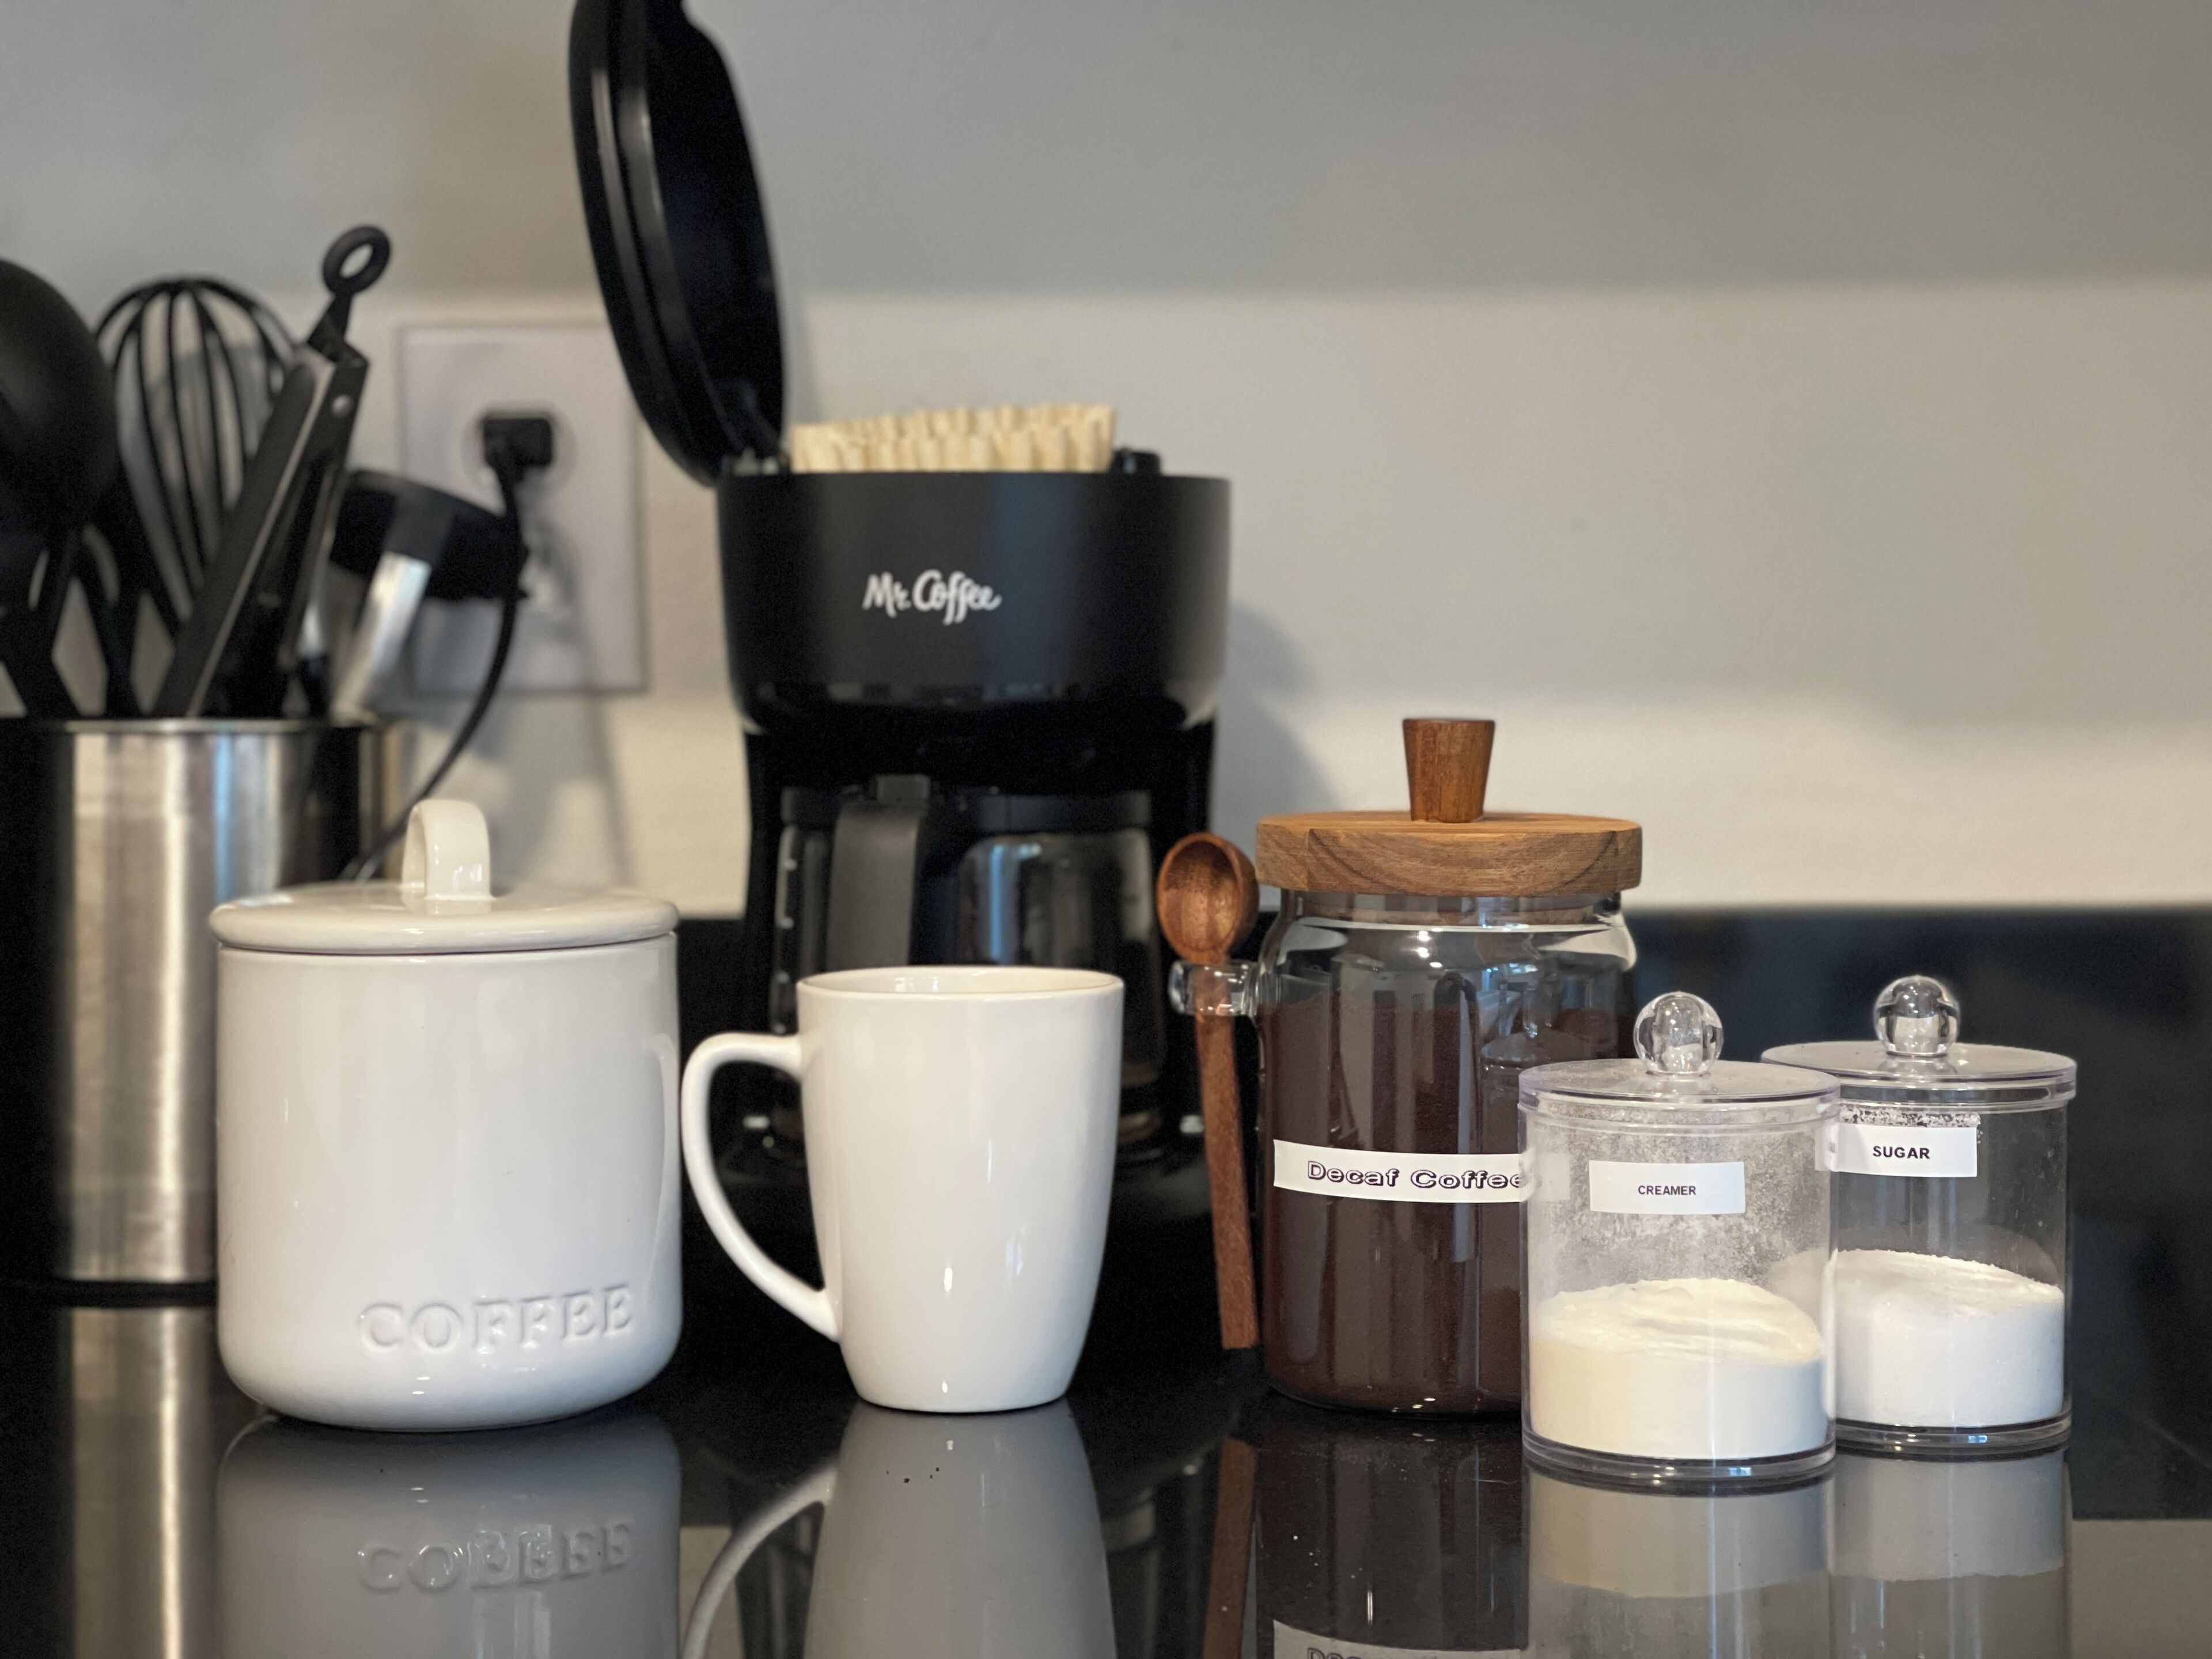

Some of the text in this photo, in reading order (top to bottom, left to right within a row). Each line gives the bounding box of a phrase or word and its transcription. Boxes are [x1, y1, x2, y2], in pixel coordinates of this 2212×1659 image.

[912, 569, 1002, 625] Coffee
[1873, 1146, 1930, 1159] SUGAR
[1308, 1161, 1400, 1187] Decaf
[1638, 1185, 1696, 1196] CREAMER
[358, 1284, 632, 1355] COFFEE
